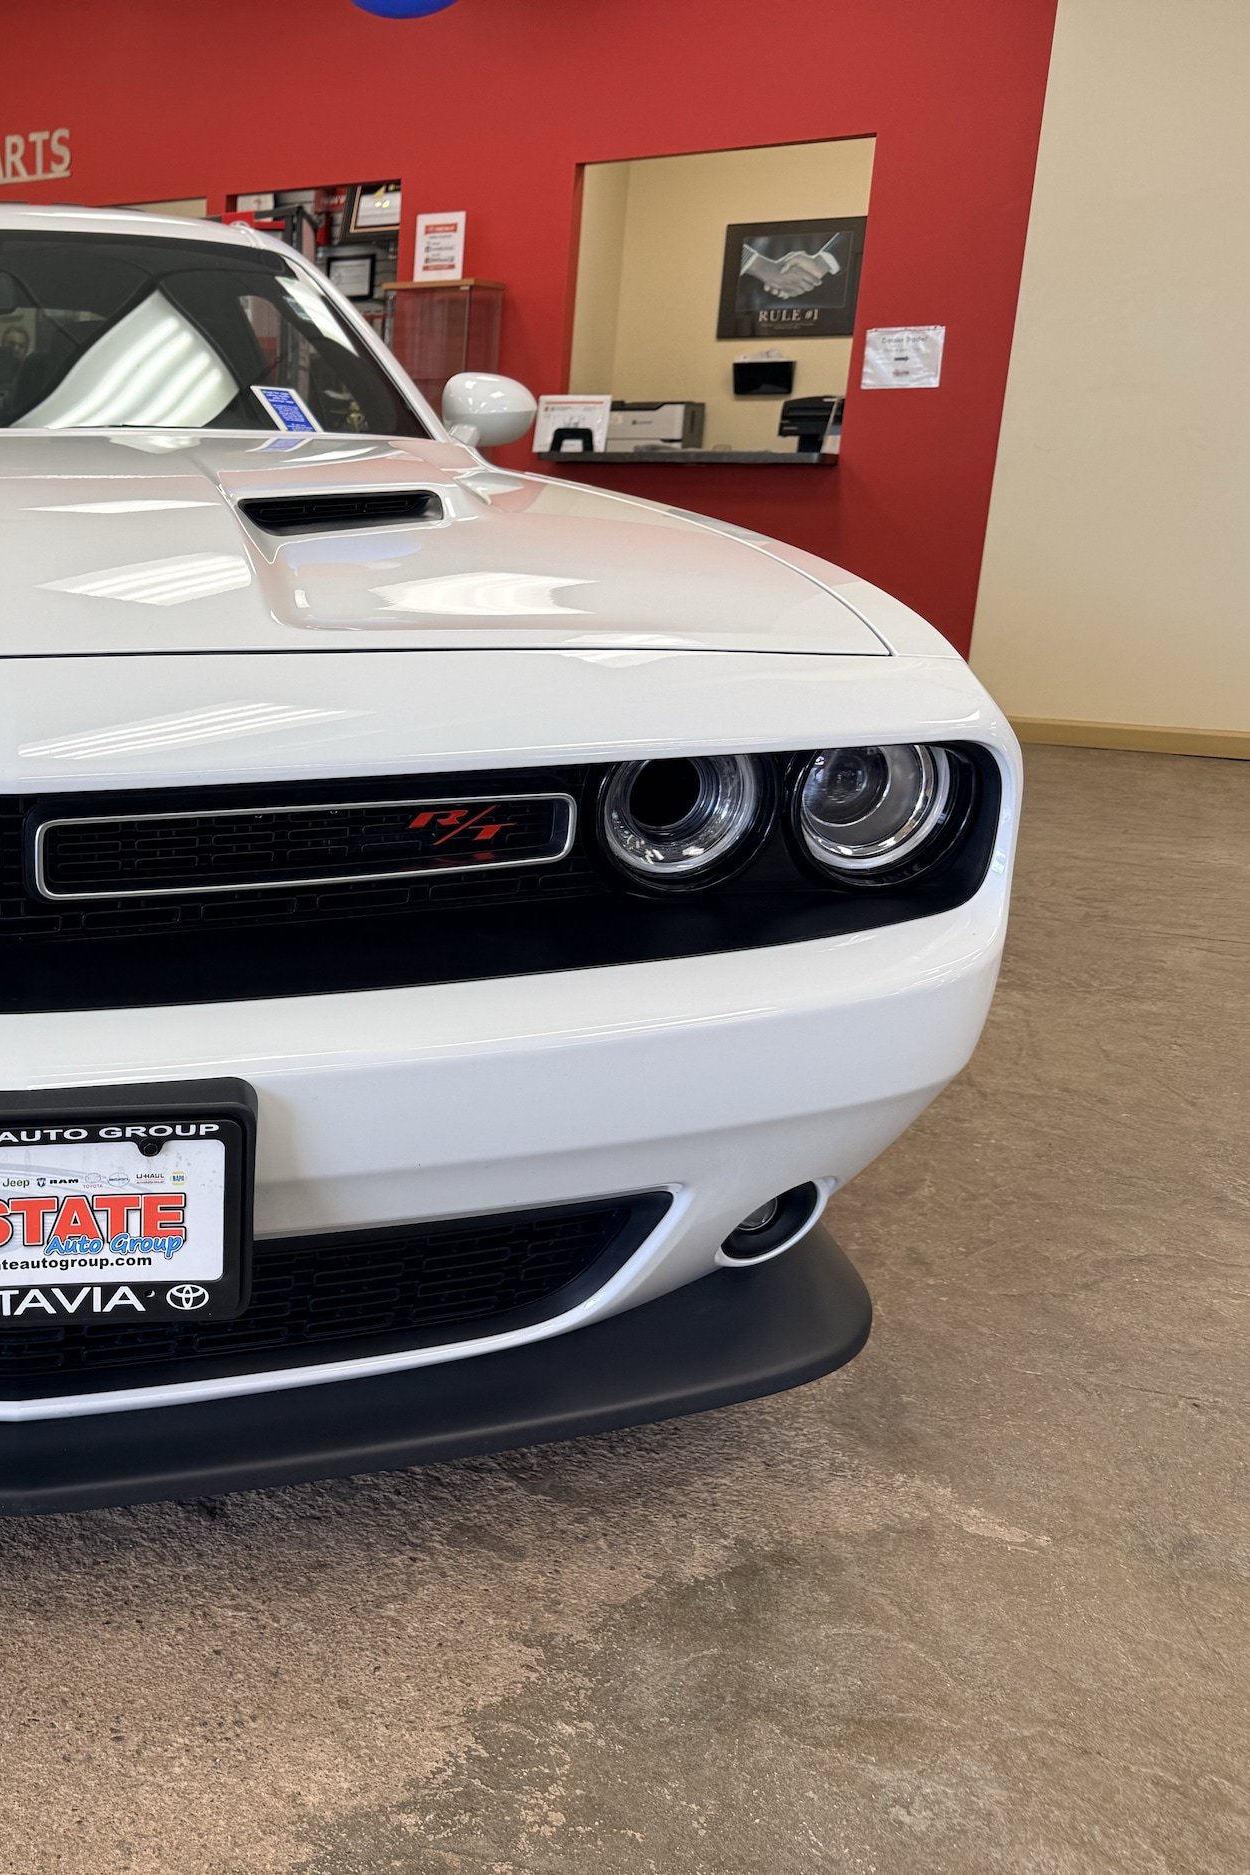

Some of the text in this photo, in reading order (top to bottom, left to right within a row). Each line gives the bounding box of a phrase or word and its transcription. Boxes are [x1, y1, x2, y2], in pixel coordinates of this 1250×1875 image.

[758, 308, 819, 322] RULE #1
[407, 804, 516, 846] R/T
[98, 1123, 220, 1140] GROUP
[2, 1178, 30, 1189] Jeep
[44, 1233, 185, 1260] Auto Group
